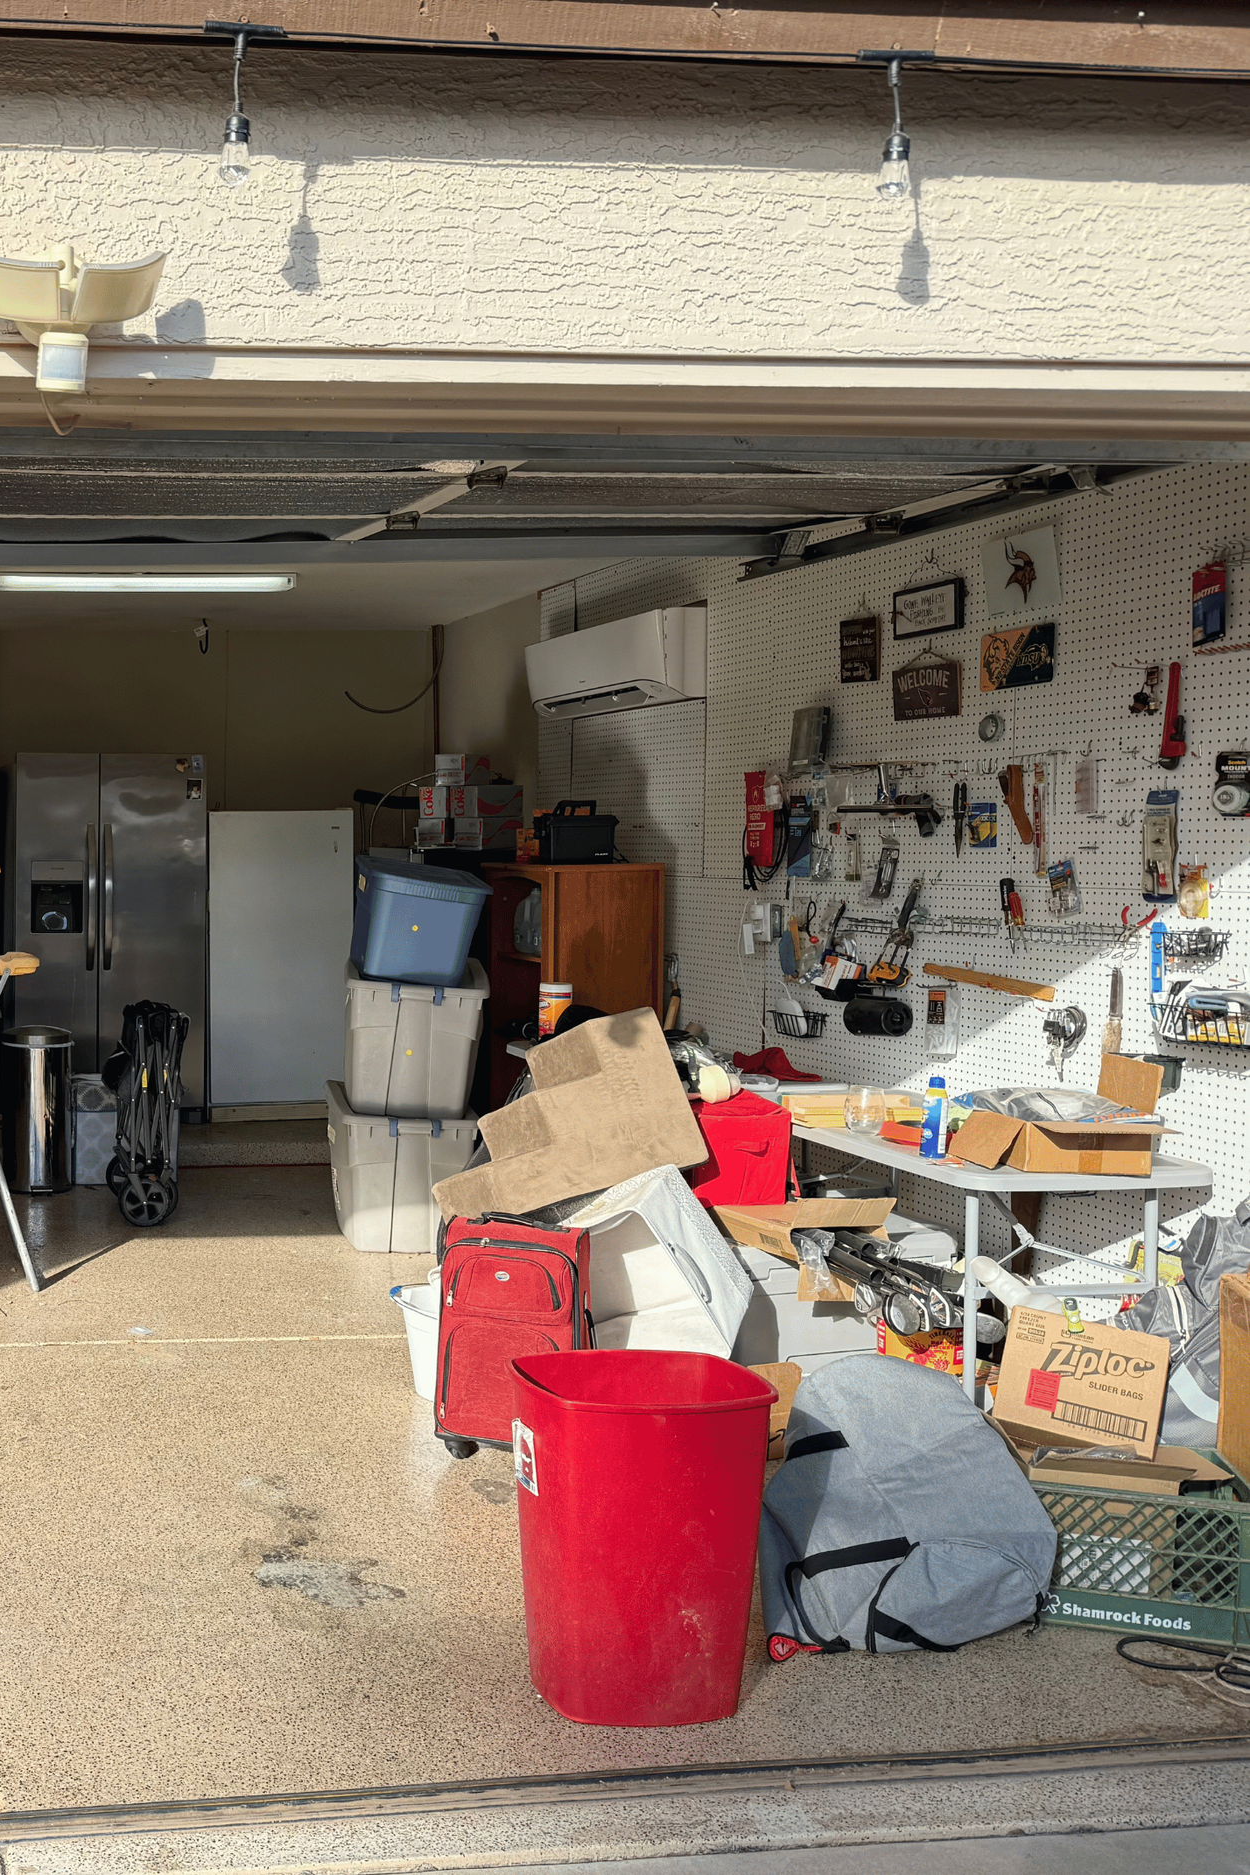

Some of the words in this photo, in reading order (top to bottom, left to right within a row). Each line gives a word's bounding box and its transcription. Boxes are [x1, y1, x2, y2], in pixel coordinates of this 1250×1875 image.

[1193, 584, 1221, 602] LOCTITE
[903, 599, 919, 610] GONE
[1012, 631, 1026, 651] BISON
[1016, 652, 1041, 667] NDSU
[897, 669, 950, 693] WELCOME
[905, 709, 913, 717] TO
[913, 708, 927, 716] OUR
[927, 706, 946, 715] HOME
[423, 787, 434, 817] Coke
[454, 786, 466, 817] Coke
[1045, 1342, 1145, 1380] Ziploc
[1088, 1380, 1119, 1395] SLIDER
[1120, 1388, 1144, 1401] BAGS
[1062, 1602, 1142, 1625] Shamrock
[1143, 1613, 1192, 1631] Foods
